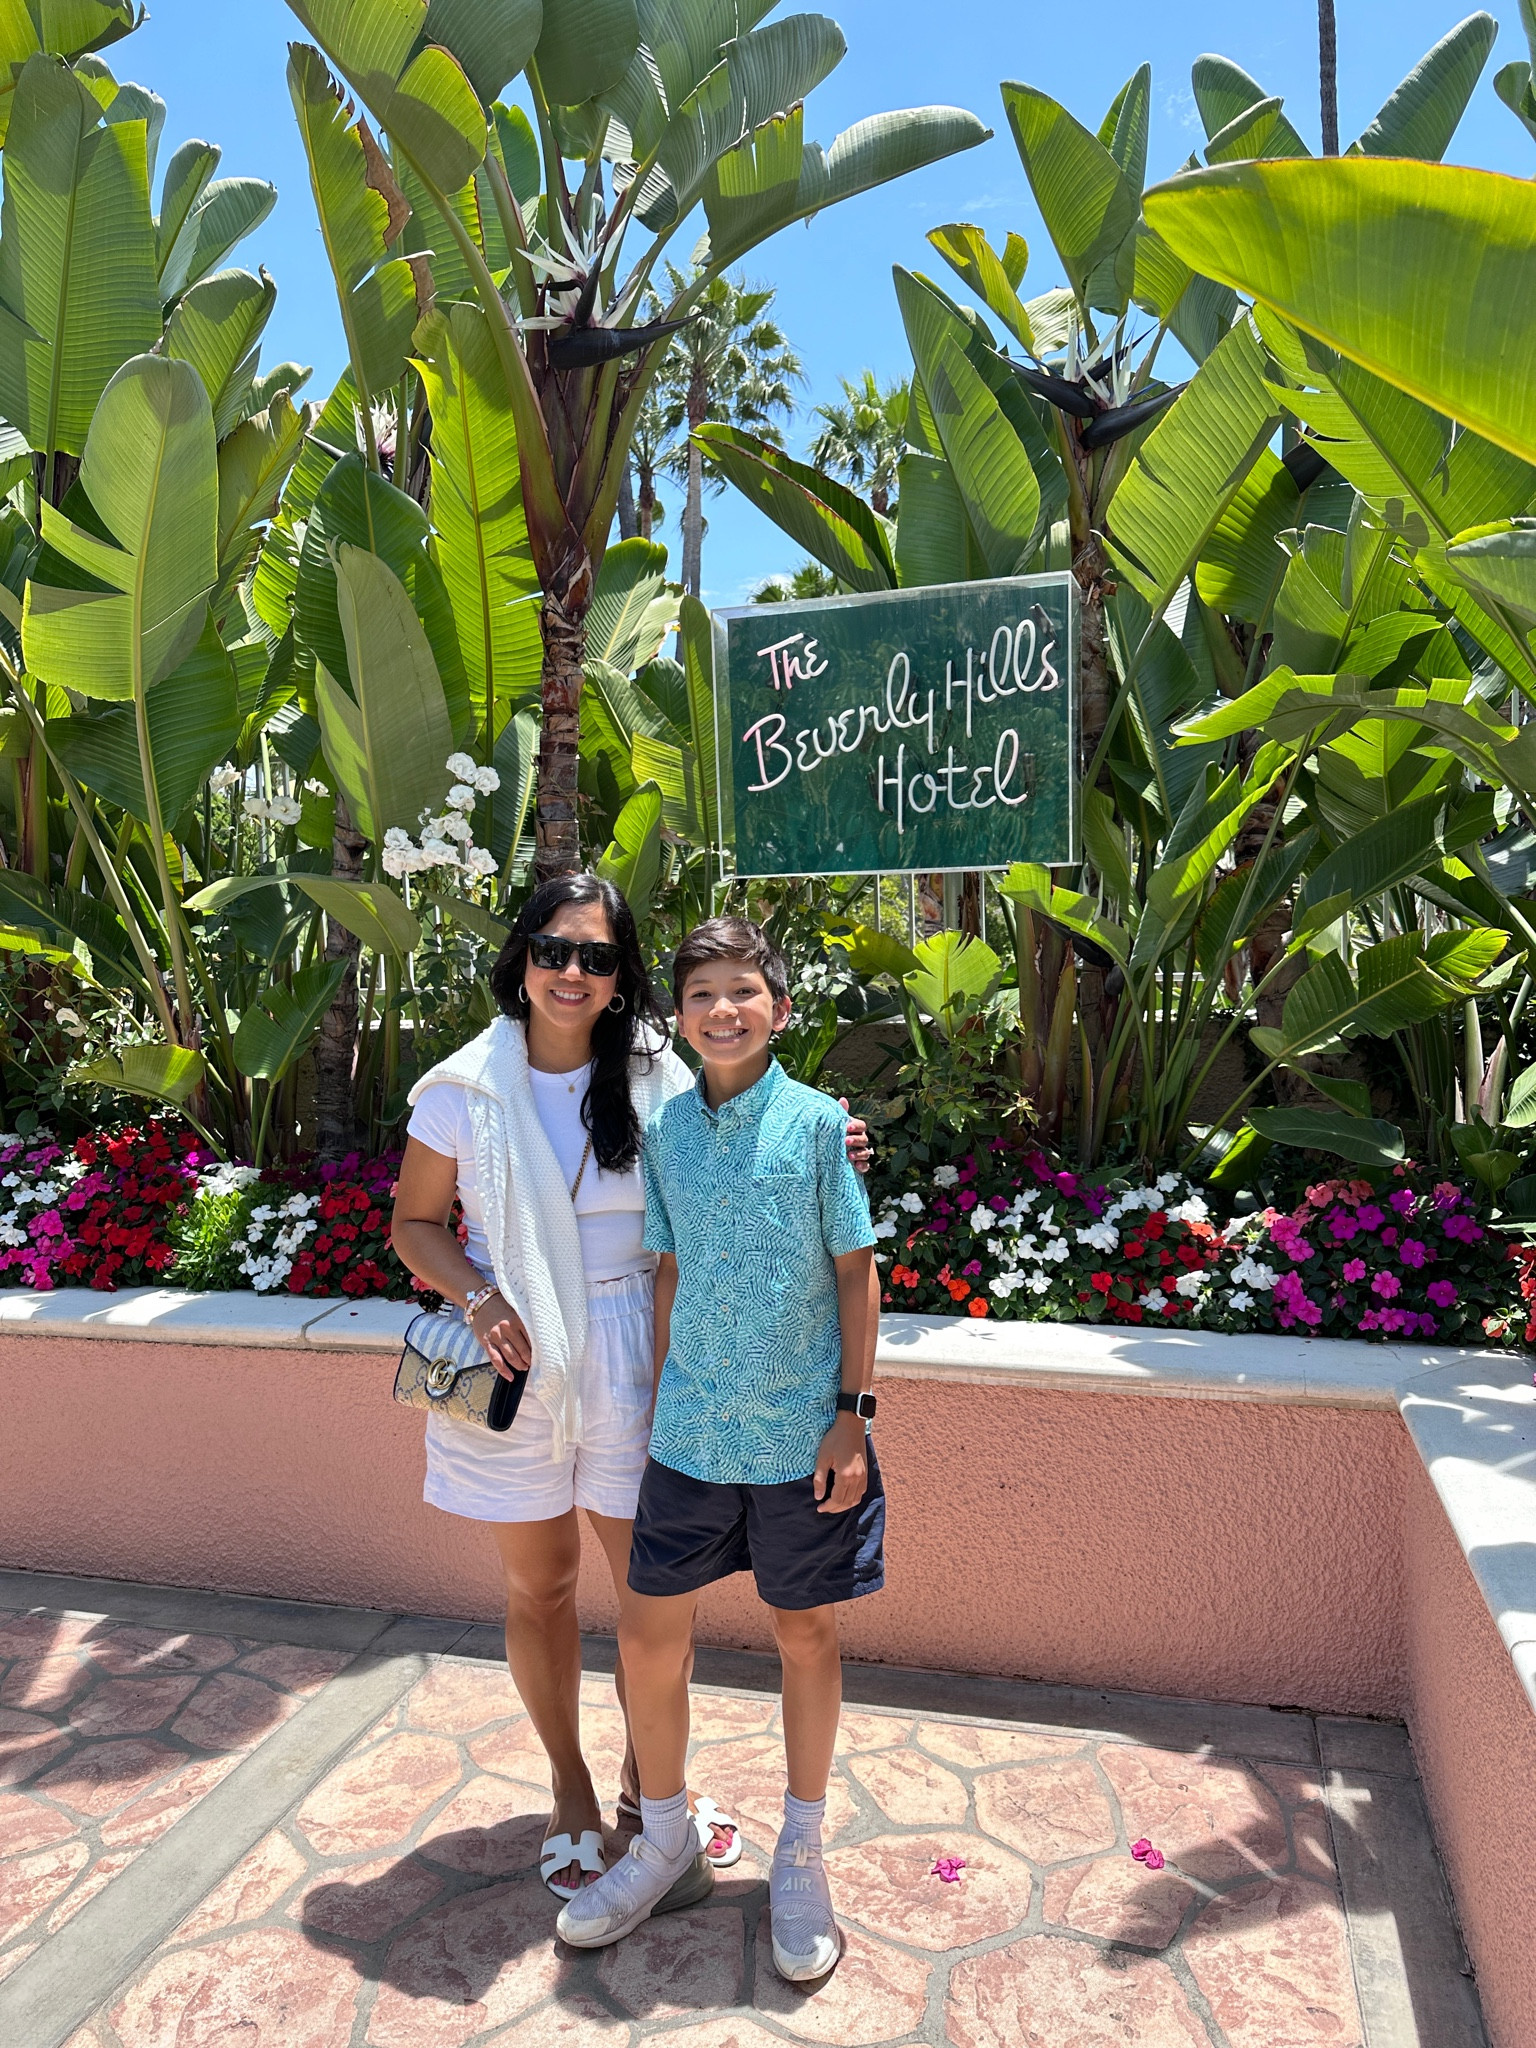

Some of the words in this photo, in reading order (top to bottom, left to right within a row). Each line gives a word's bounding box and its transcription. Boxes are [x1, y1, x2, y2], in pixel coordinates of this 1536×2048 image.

[757, 633, 829, 690] The
[743, 652, 935, 791] Beverly
[946, 619, 1059, 738] Hills
[878, 728, 1028, 835] Hotel
[780, 1876, 812, 1893] AIR
